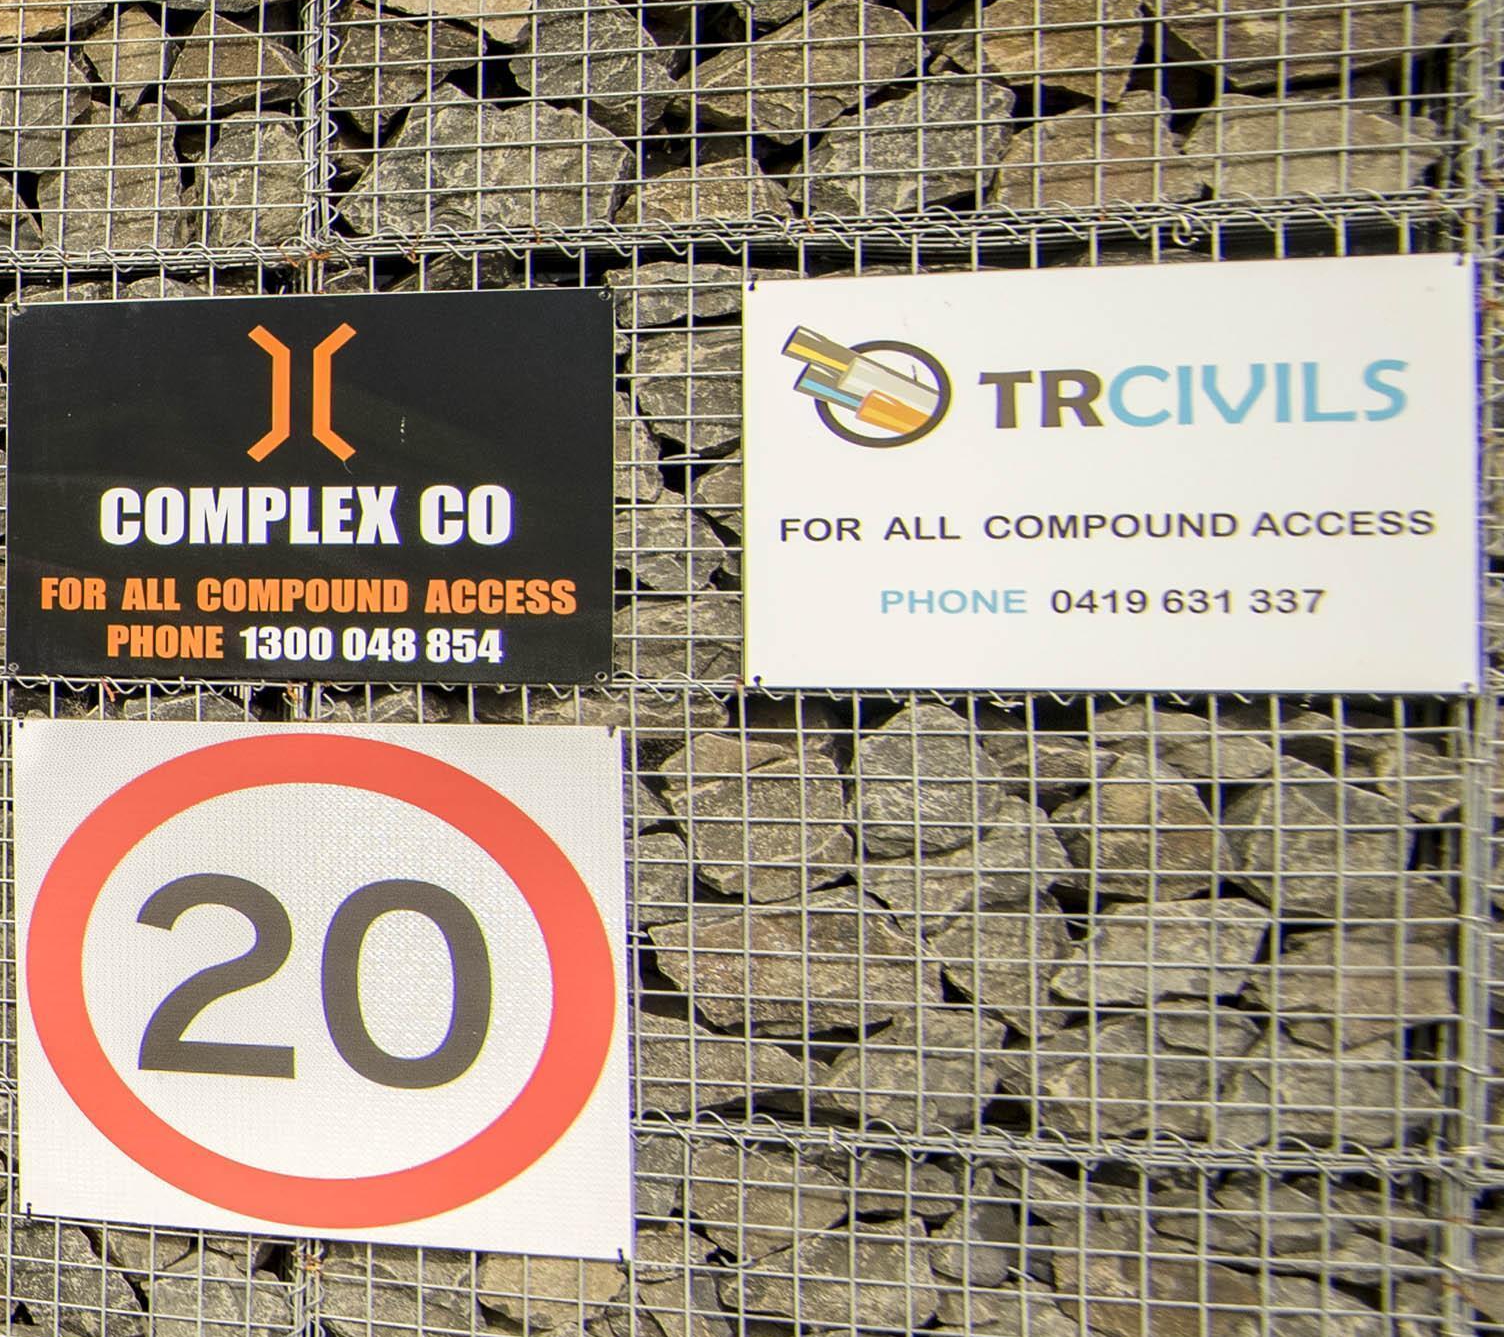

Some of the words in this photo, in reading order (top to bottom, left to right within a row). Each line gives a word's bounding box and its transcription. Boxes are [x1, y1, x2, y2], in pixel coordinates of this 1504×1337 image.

[978, 359, 1408, 430] TRCIVILS
[99, 485, 402, 546] COMPLEX
[419, 484, 515, 547] CO
[779, 516, 862, 543] FOR
[884, 515, 962, 541] ALL
[983, 512, 1240, 540] COMPOUND
[1251, 509, 1437, 538] ACCESS
[40, 576, 107, 611] FOR
[121, 577, 182, 612] ALL
[196, 577, 409, 614] COMPOUND
[424, 578, 577, 616] ACCESS
[880, 588, 1026, 615] PHONE
[1050, 588, 1150, 615] 0419
[1161, 588, 1233, 615] 631
[1249, 588, 1328, 615] 337
[107, 624, 224, 660] PHONE
[239, 625, 335, 662] 1300
[341, 626, 418, 663] 048
[425, 627, 506, 665] 854
[136, 872, 492, 1090] 20
